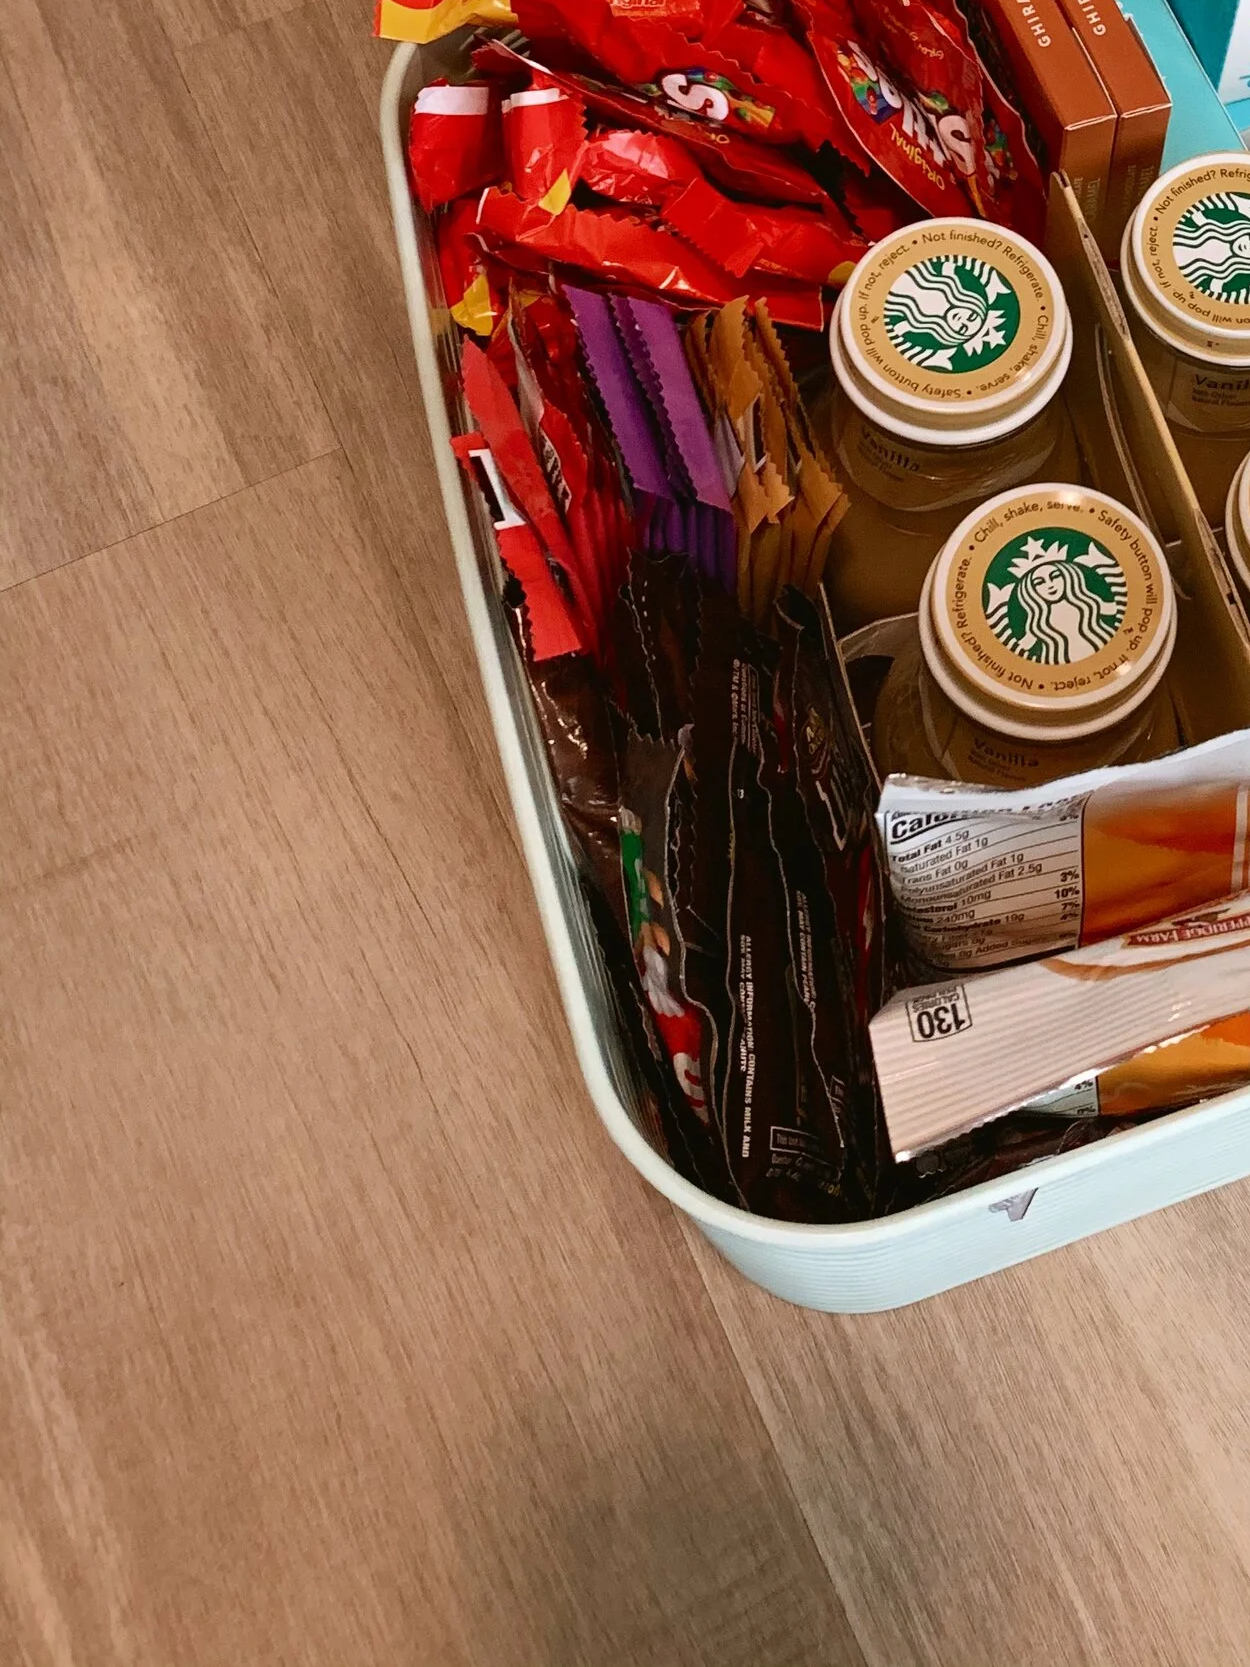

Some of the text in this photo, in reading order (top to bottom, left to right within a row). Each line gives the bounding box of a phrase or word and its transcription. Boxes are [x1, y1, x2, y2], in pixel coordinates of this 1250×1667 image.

[1155, 195, 1174, 215] Not
[1171, 169, 1217, 196] finished?
[921, 230, 1047, 303] Not finished? Refrigerate.
[858, 244, 962, 398] Safety button will pop up. If not, reject.
[976, 314, 1050, 392] Chill, shake, serve.
[974, 501, 1044, 544] Chill, shake,
[1097, 509, 1154, 583] Safety button
[1054, 885, 1080, 900] 10%
[1060, 870, 1080, 882] 3%
[1129, 927, 1179, 945] FARM
[917, 1003, 966, 1039] 130
